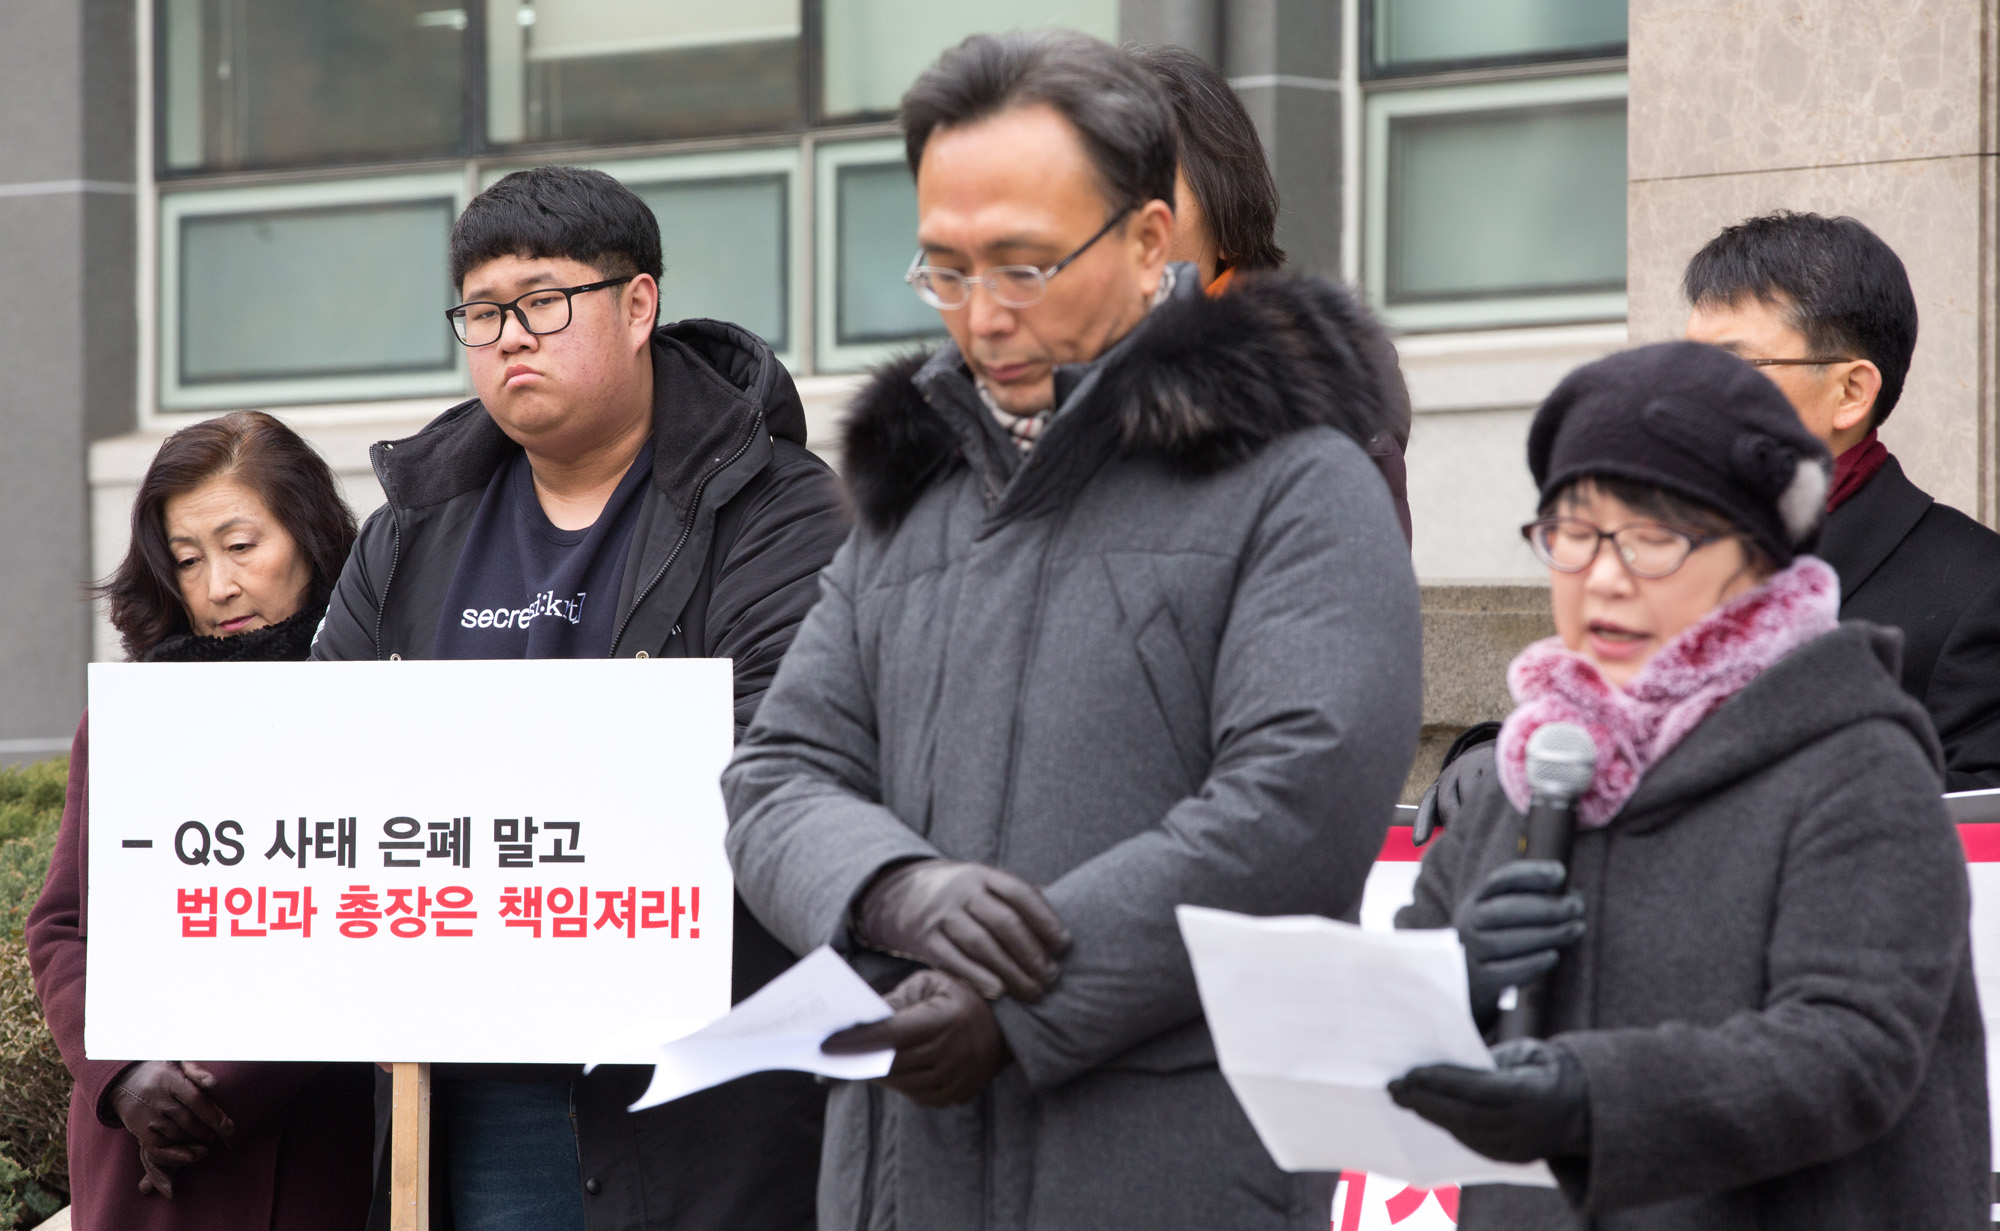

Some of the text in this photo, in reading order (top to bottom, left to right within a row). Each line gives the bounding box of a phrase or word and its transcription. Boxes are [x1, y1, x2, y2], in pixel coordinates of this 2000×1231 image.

[174, 819, 245, 867] QS
[264, 816, 357, 869] 사태
[378, 816, 471, 869] 은폐
[493, 816, 586, 868] 말고
[176, 884, 700, 939] 법인과 총장은 책임져라!
